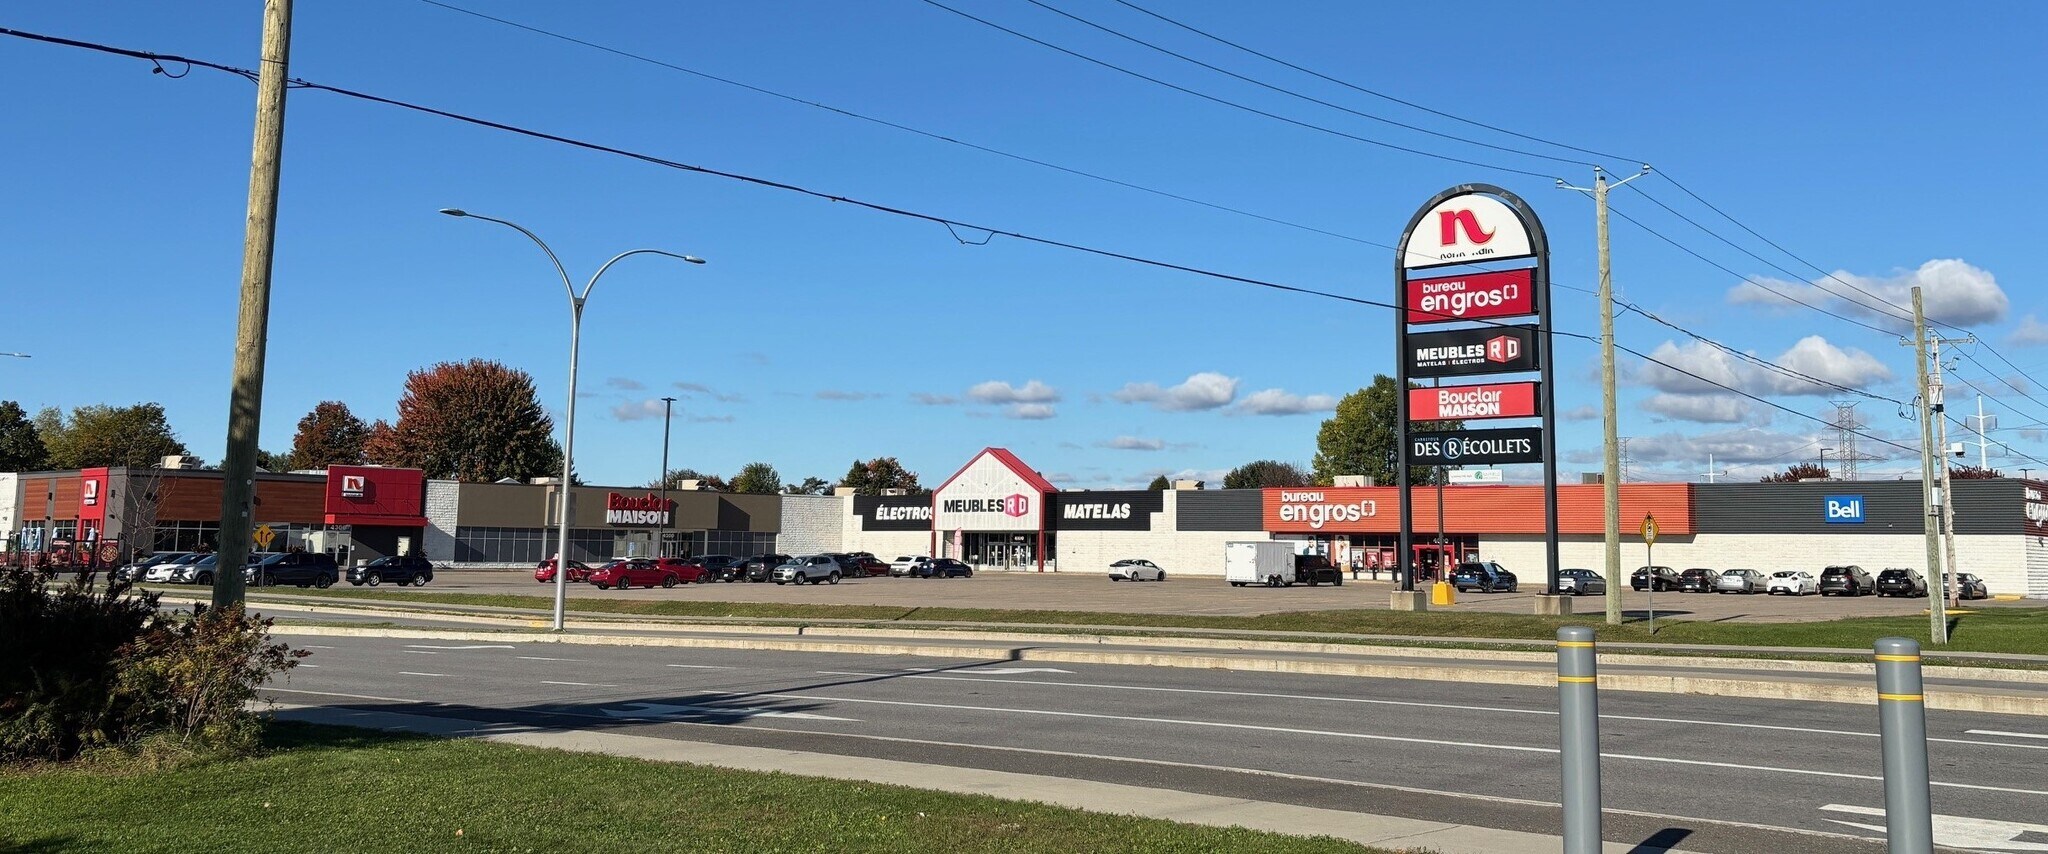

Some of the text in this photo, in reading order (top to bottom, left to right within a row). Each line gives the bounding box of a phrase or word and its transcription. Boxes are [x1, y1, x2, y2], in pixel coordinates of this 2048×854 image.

[1422, 281, 1466, 294] bureau
[1420, 289, 1503, 316] en gros
[1416, 344, 1485, 361] MEUBLES
[1416, 357, 1485, 368] MATELAS ÉLECTROS
[1438, 387, 1502, 405] Bouclair
[1438, 401, 1501, 417] MAISON
[1414, 437, 1531, 457] DES RÉCOLLETS
[1281, 490, 1324, 502] bureau
[943, 499, 1005, 513] MEUBLES
[1063, 503, 1131, 519] MATELAS
[1828, 500, 1860, 518] Bell
[606, 509, 669, 525] MAISON
[1279, 503, 1361, 529] en gros
